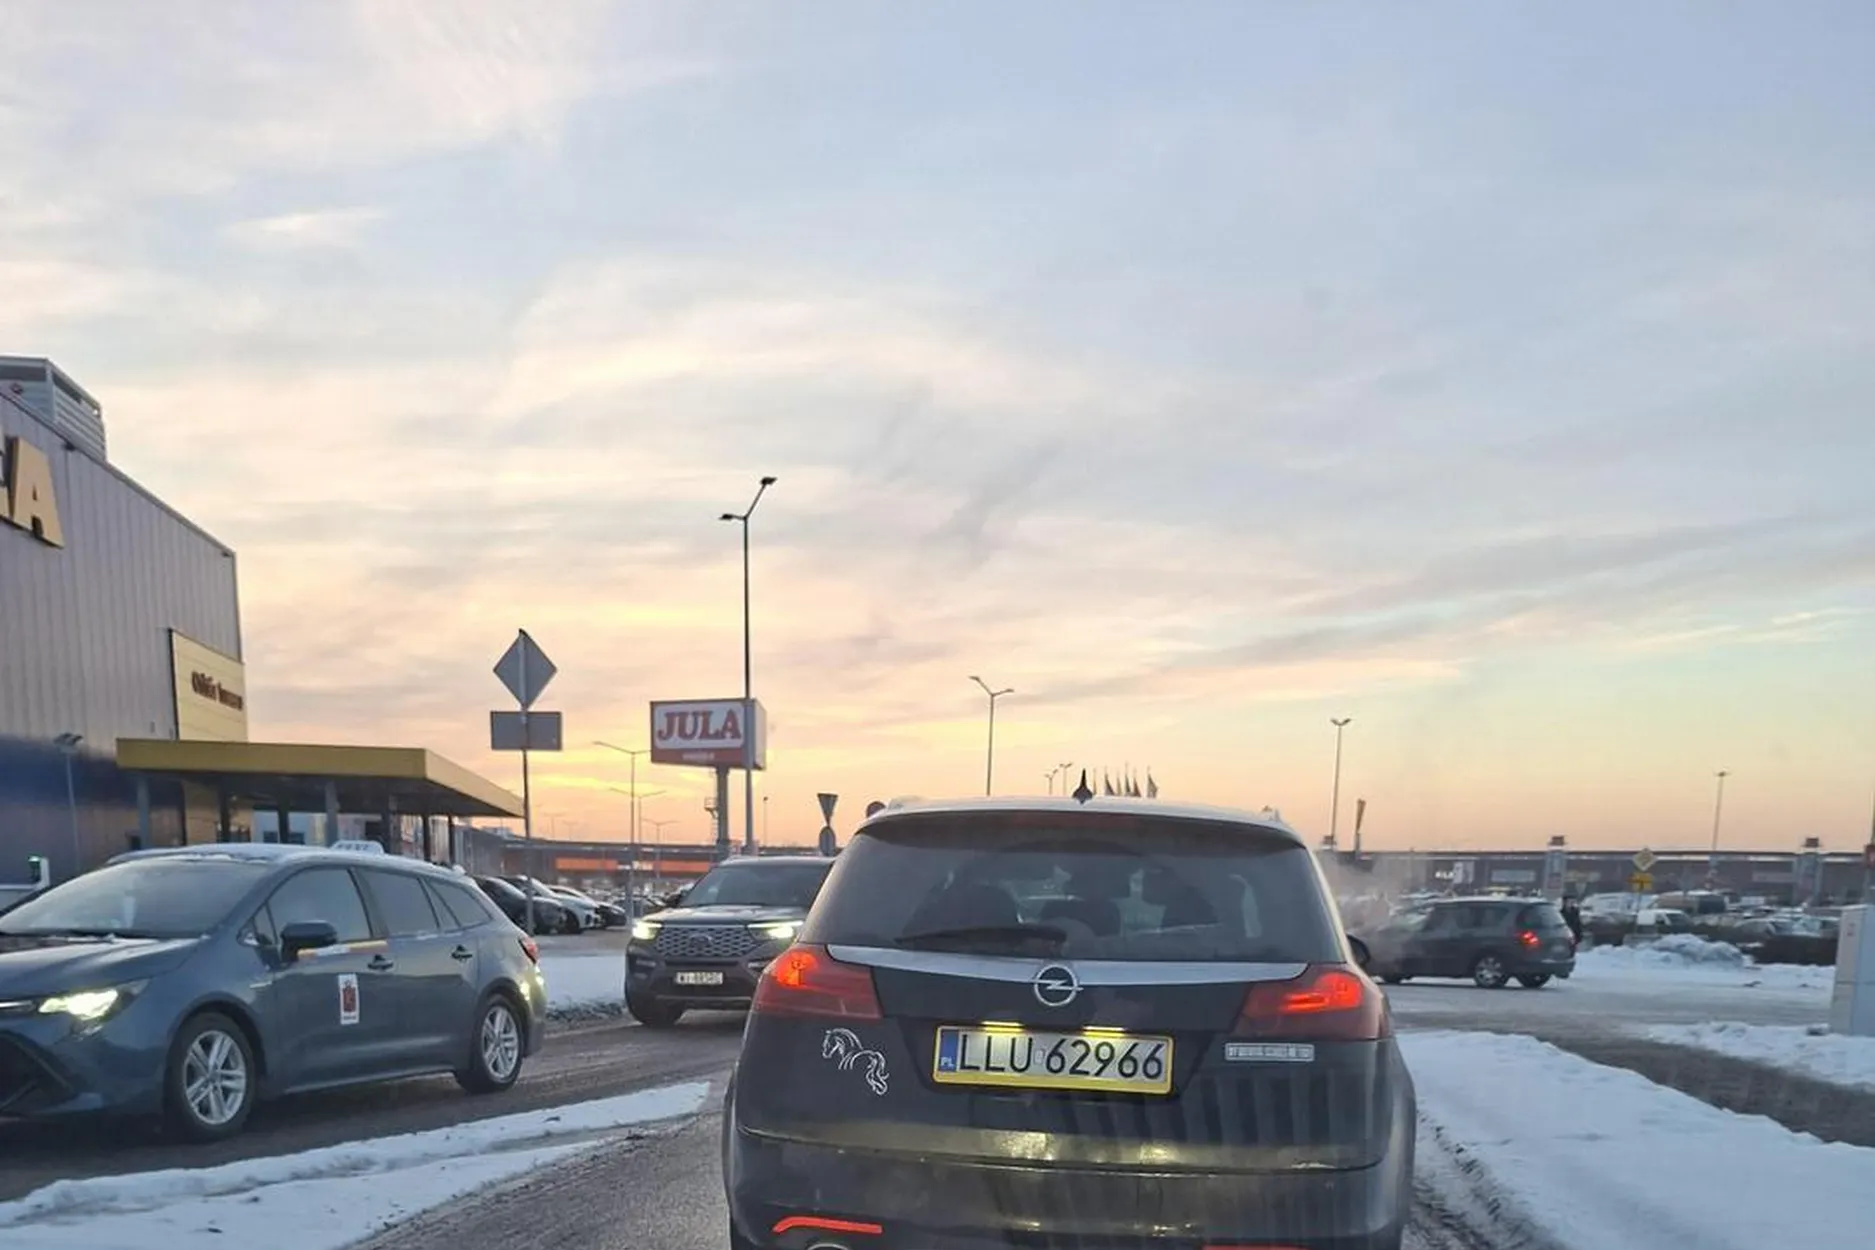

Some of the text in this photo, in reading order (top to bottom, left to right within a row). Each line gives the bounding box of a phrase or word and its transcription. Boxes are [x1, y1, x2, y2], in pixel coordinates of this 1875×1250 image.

[0, 434, 64, 547] A
[657, 709, 742, 741] JULA
[959, 1033, 1033, 1074] LLU
[1046, 1037, 1165, 1080] 62966
